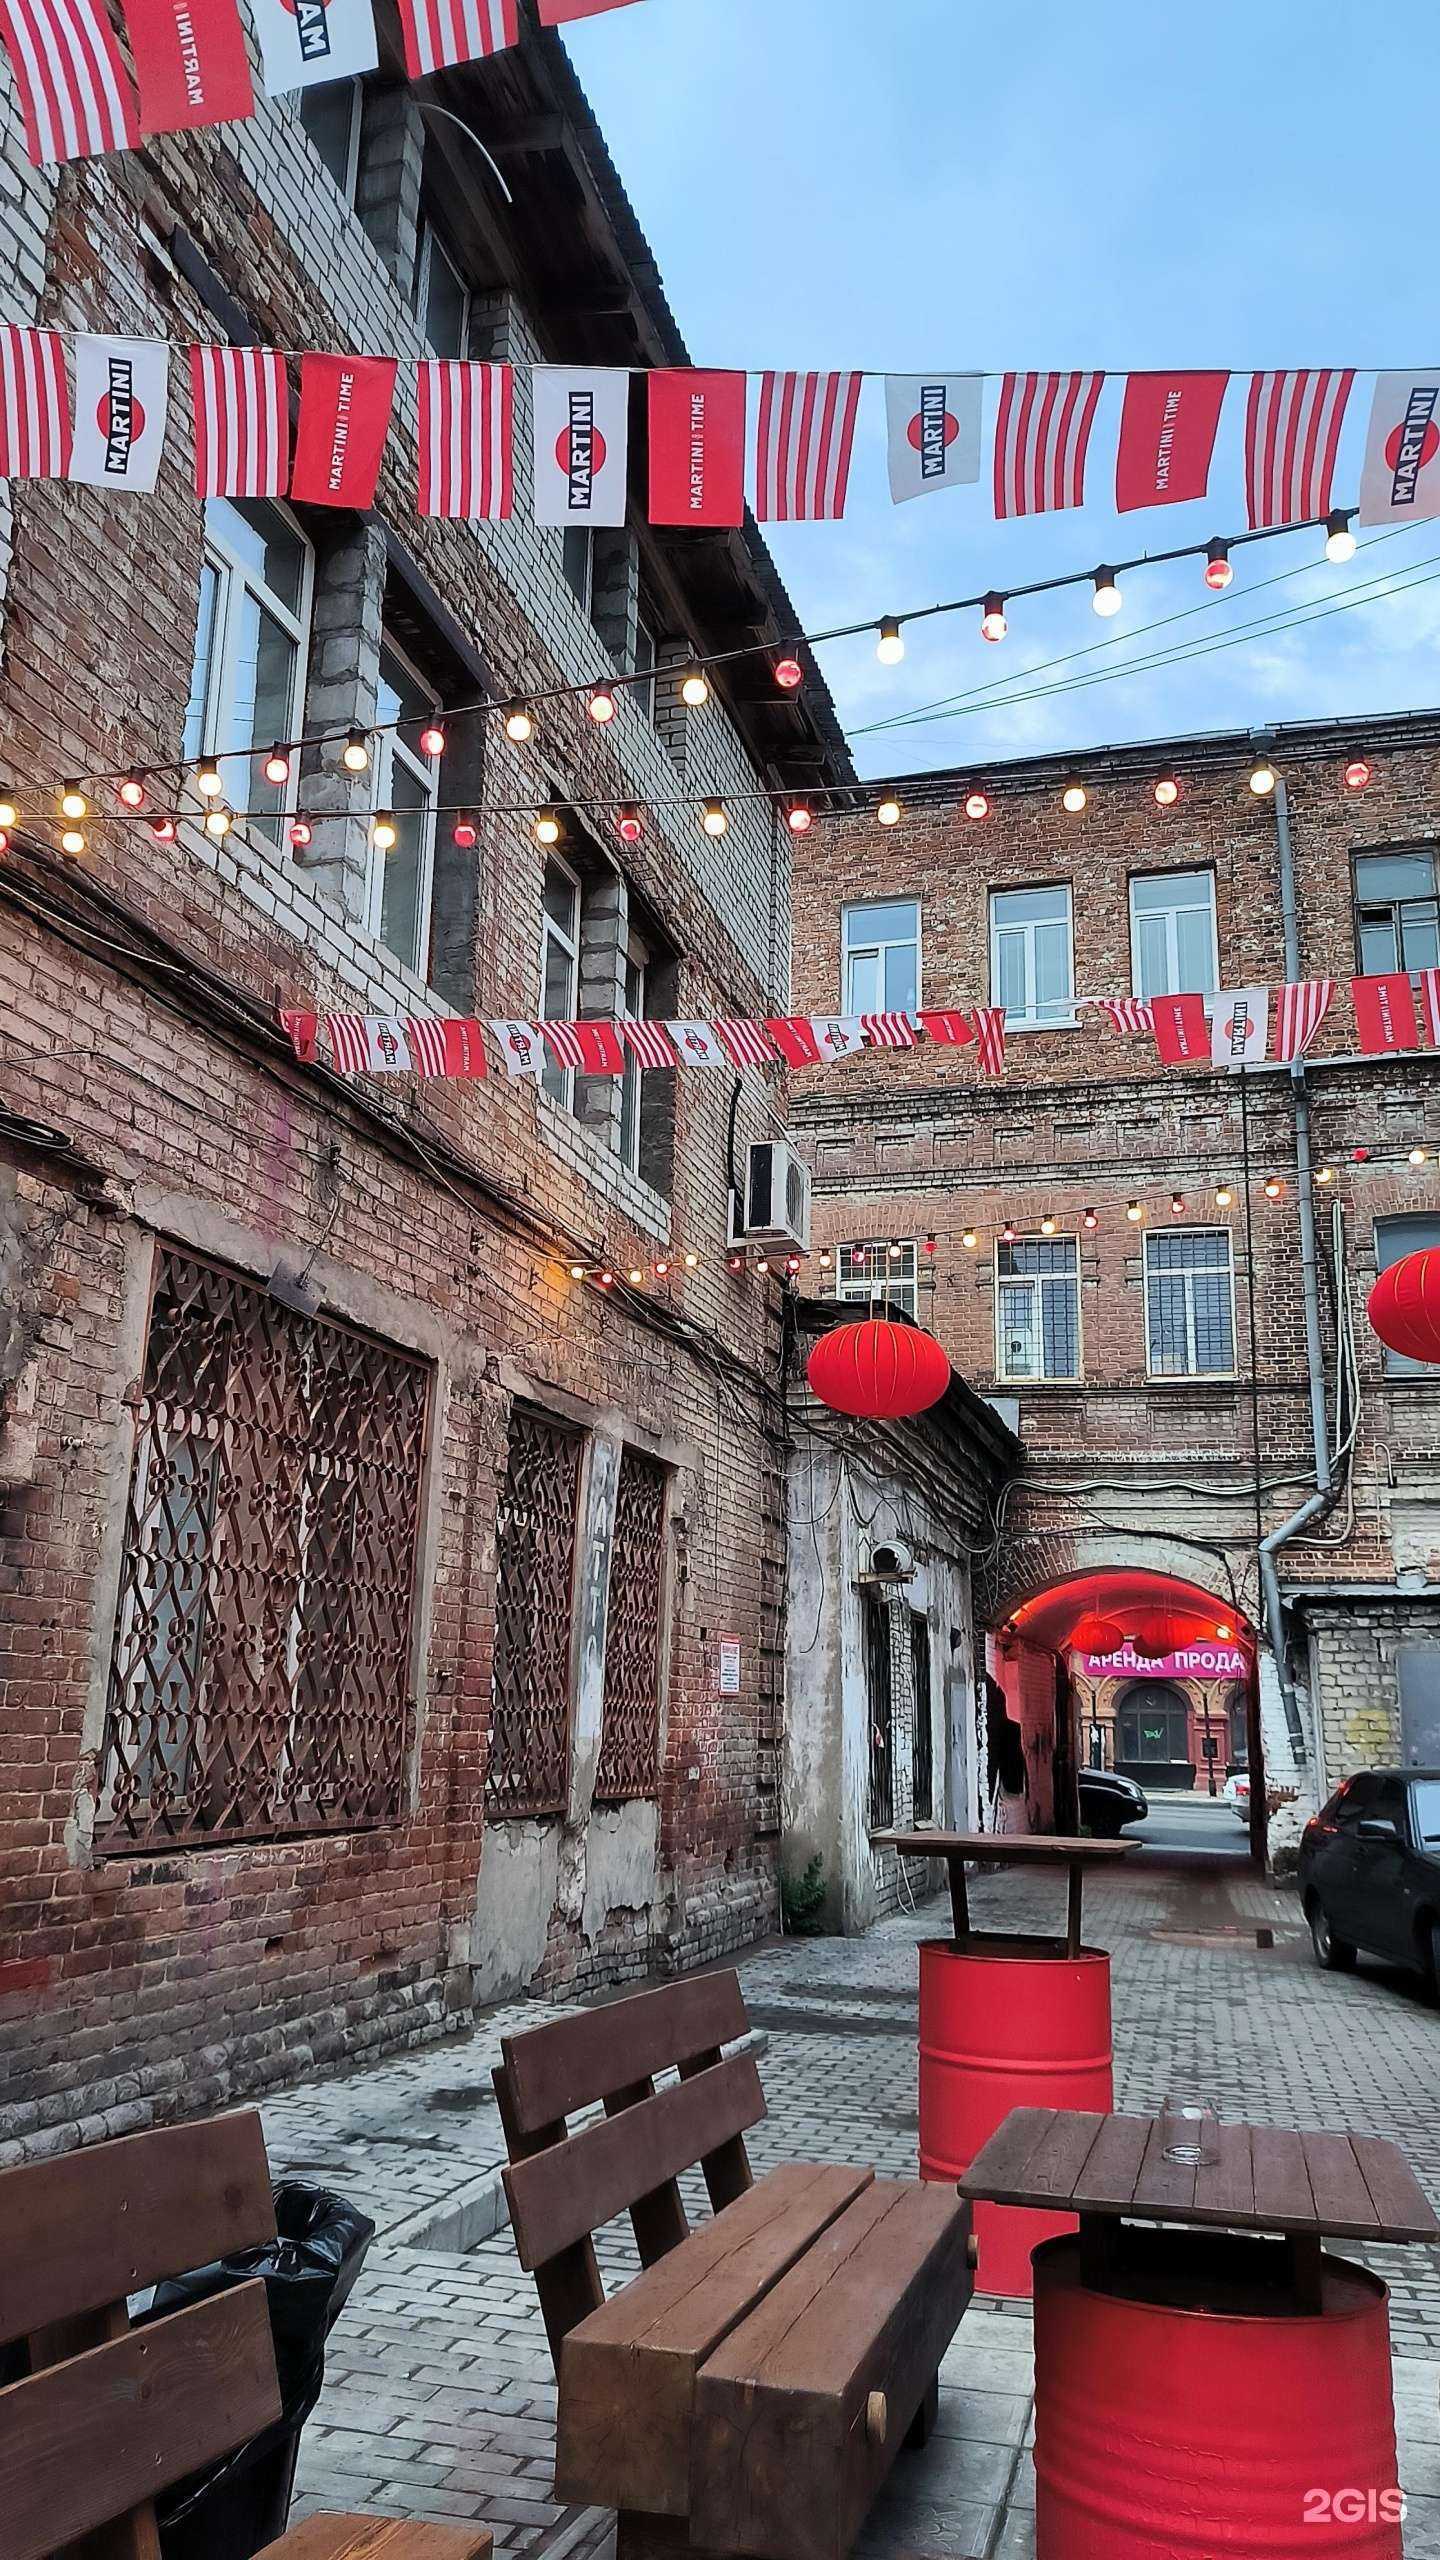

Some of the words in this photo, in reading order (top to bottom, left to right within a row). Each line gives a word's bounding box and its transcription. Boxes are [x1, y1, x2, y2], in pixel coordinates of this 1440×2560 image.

[108, 362, 130, 470] MARTINI
[338, 373, 354, 412] TIME
[691, 393, 705, 431] TIME
[1163, 391, 1182, 422] TIME
[329, 422, 349, 490] MARTINI
[571, 396, 591, 505] MARTINI
[923, 389, 944, 474] MARTINI
[1156, 429, 1175, 490] MARTINI
[1394, 392, 1435, 500] MARTINI
[689, 441, 704, 509] MARTINI
